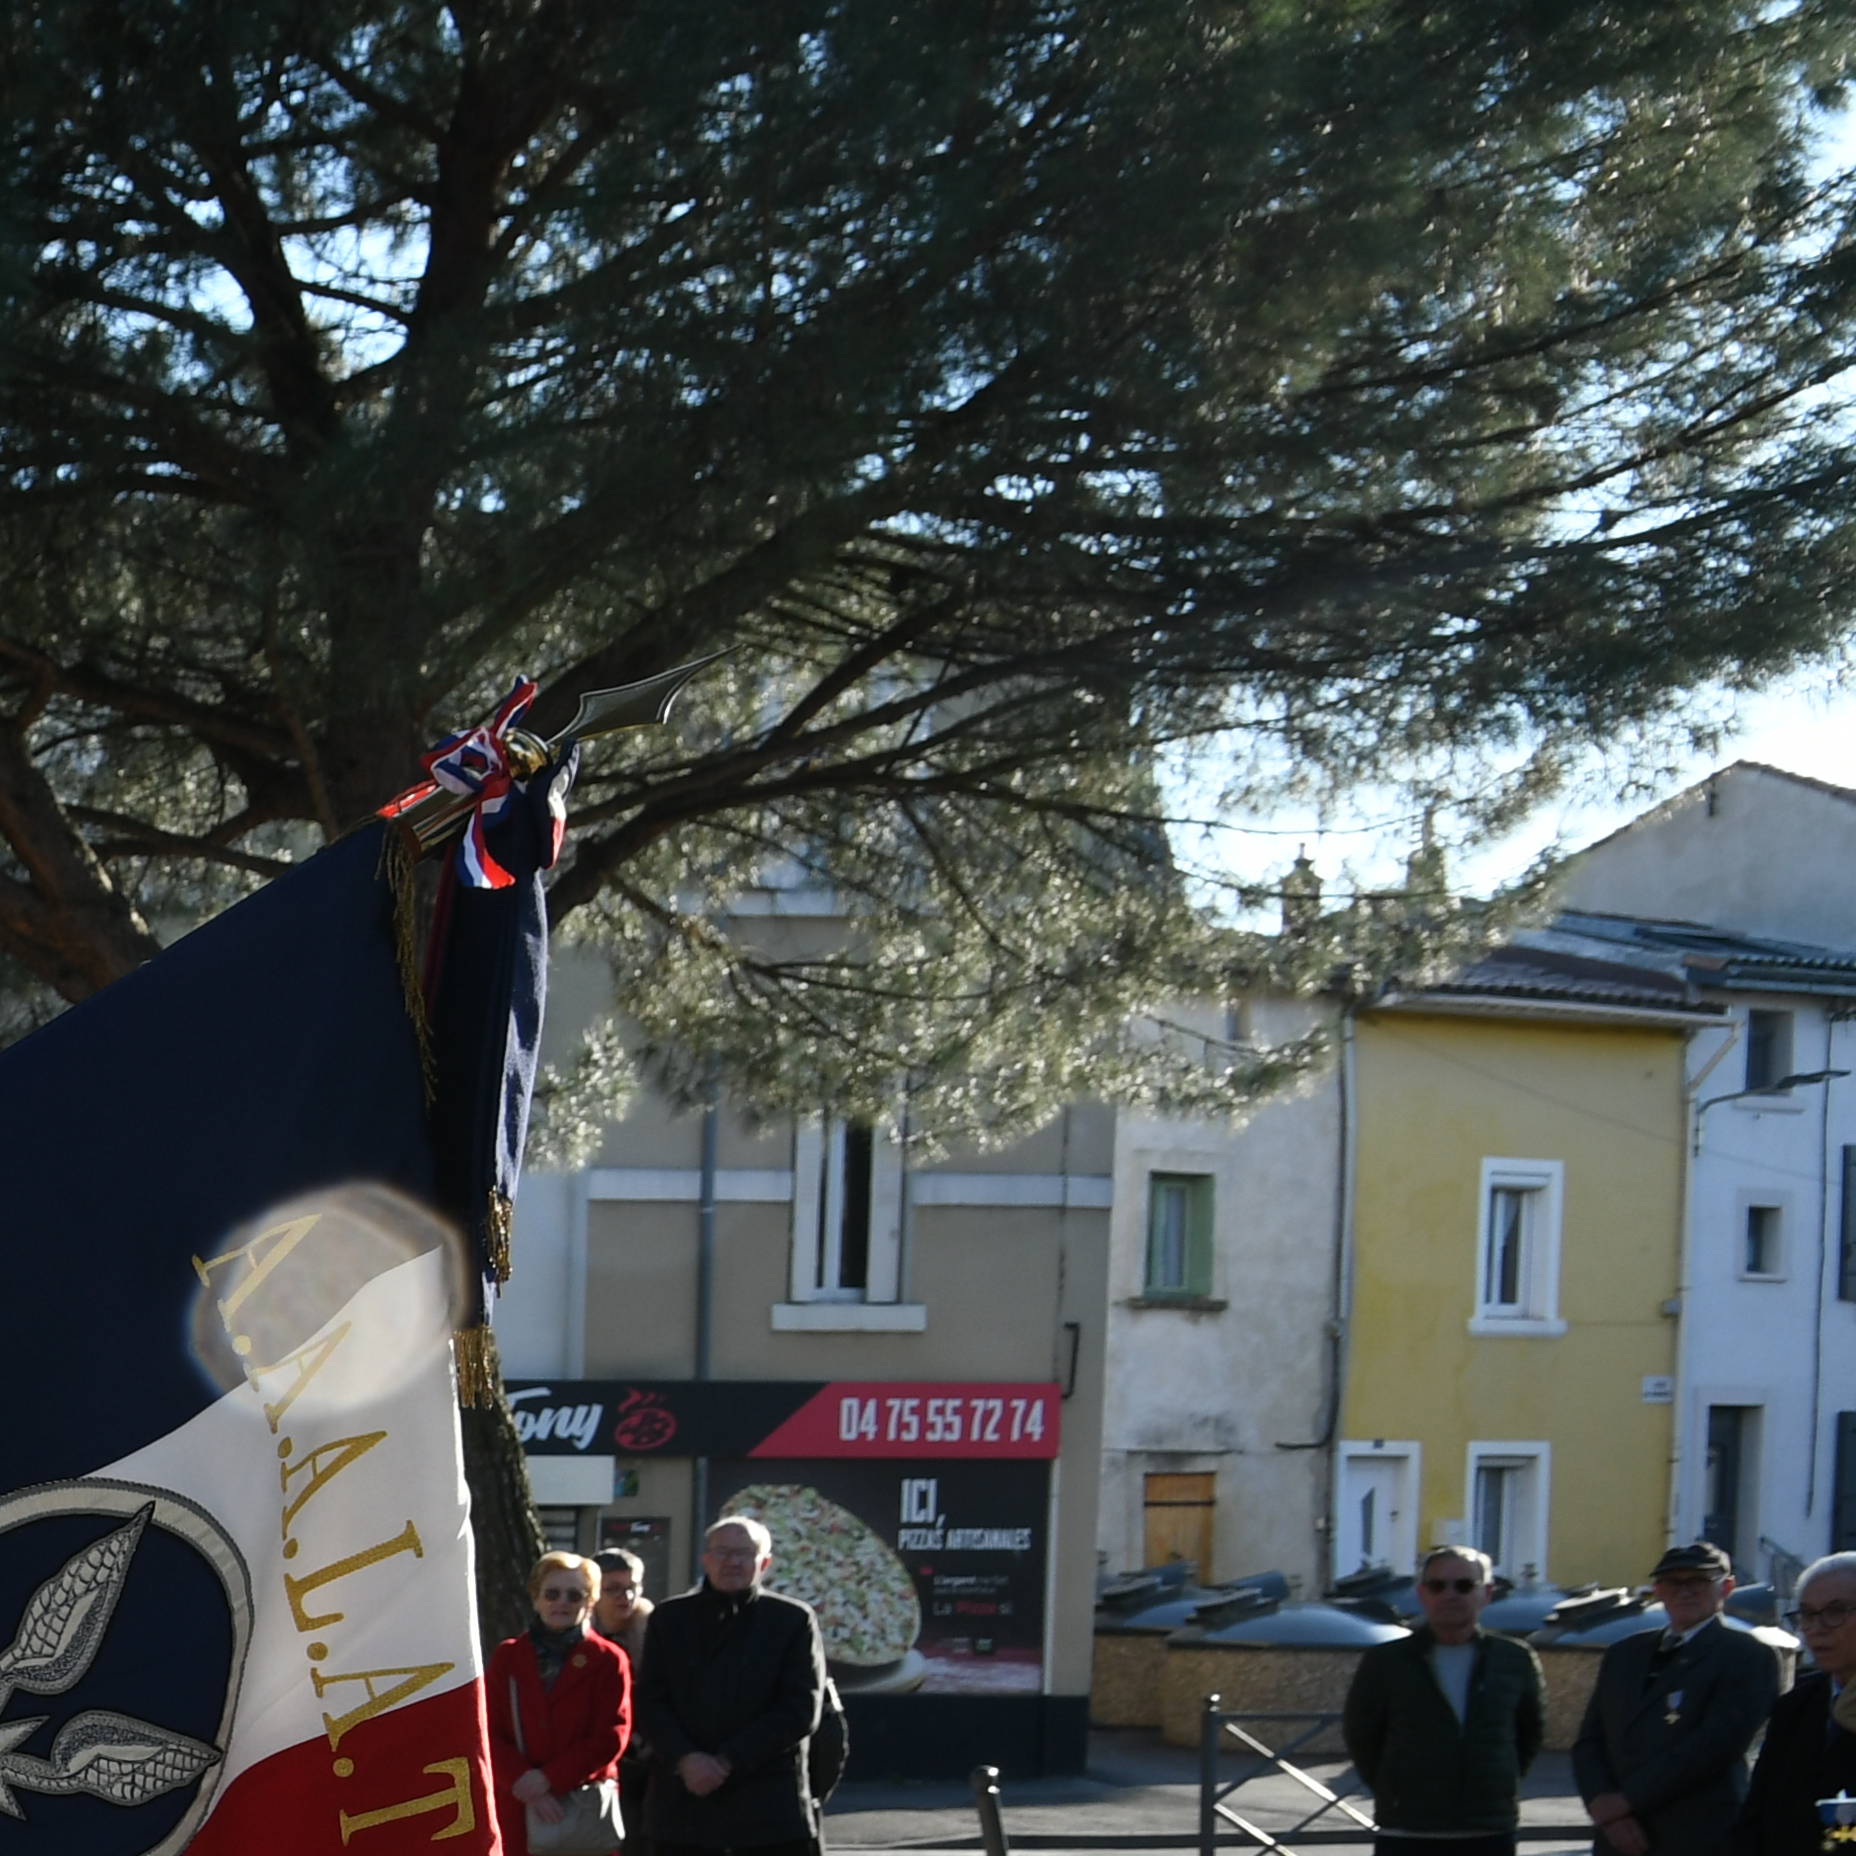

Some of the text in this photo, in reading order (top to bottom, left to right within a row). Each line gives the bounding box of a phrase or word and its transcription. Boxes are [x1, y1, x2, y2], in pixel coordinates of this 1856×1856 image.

[839, 1398, 1045, 1442] 04 75 55 72 74
